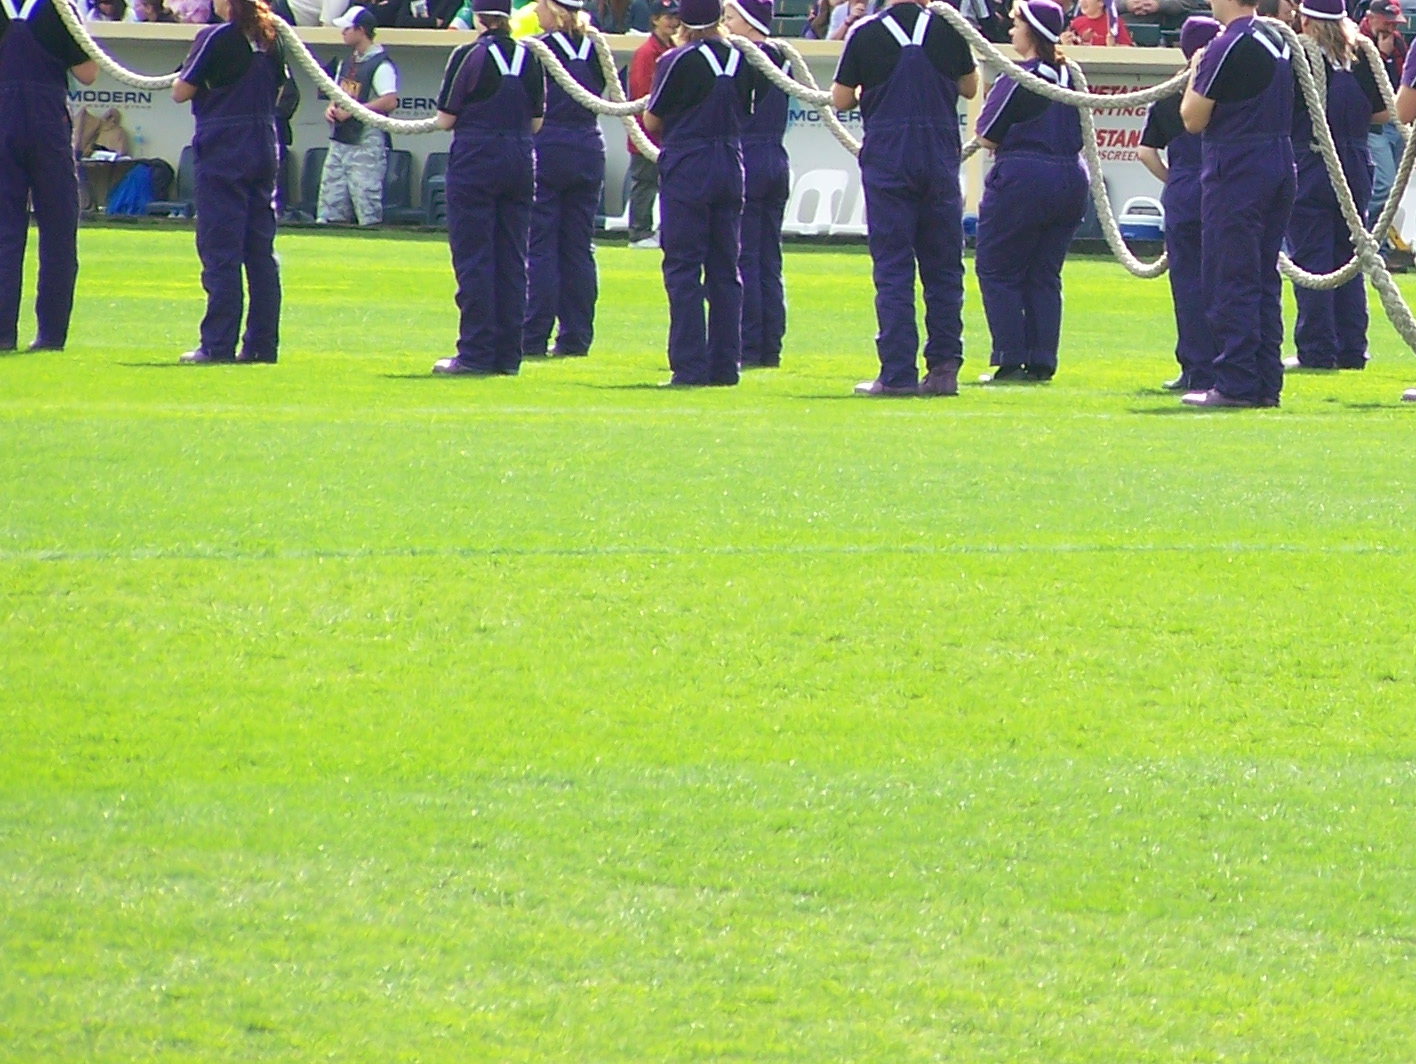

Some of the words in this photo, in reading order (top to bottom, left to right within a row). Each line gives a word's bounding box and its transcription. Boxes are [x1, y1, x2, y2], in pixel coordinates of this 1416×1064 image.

[68, 91, 152, 103] MODERN
[789, 110, 861, 122] MOER
[1096, 129, 1141, 148] STAN
